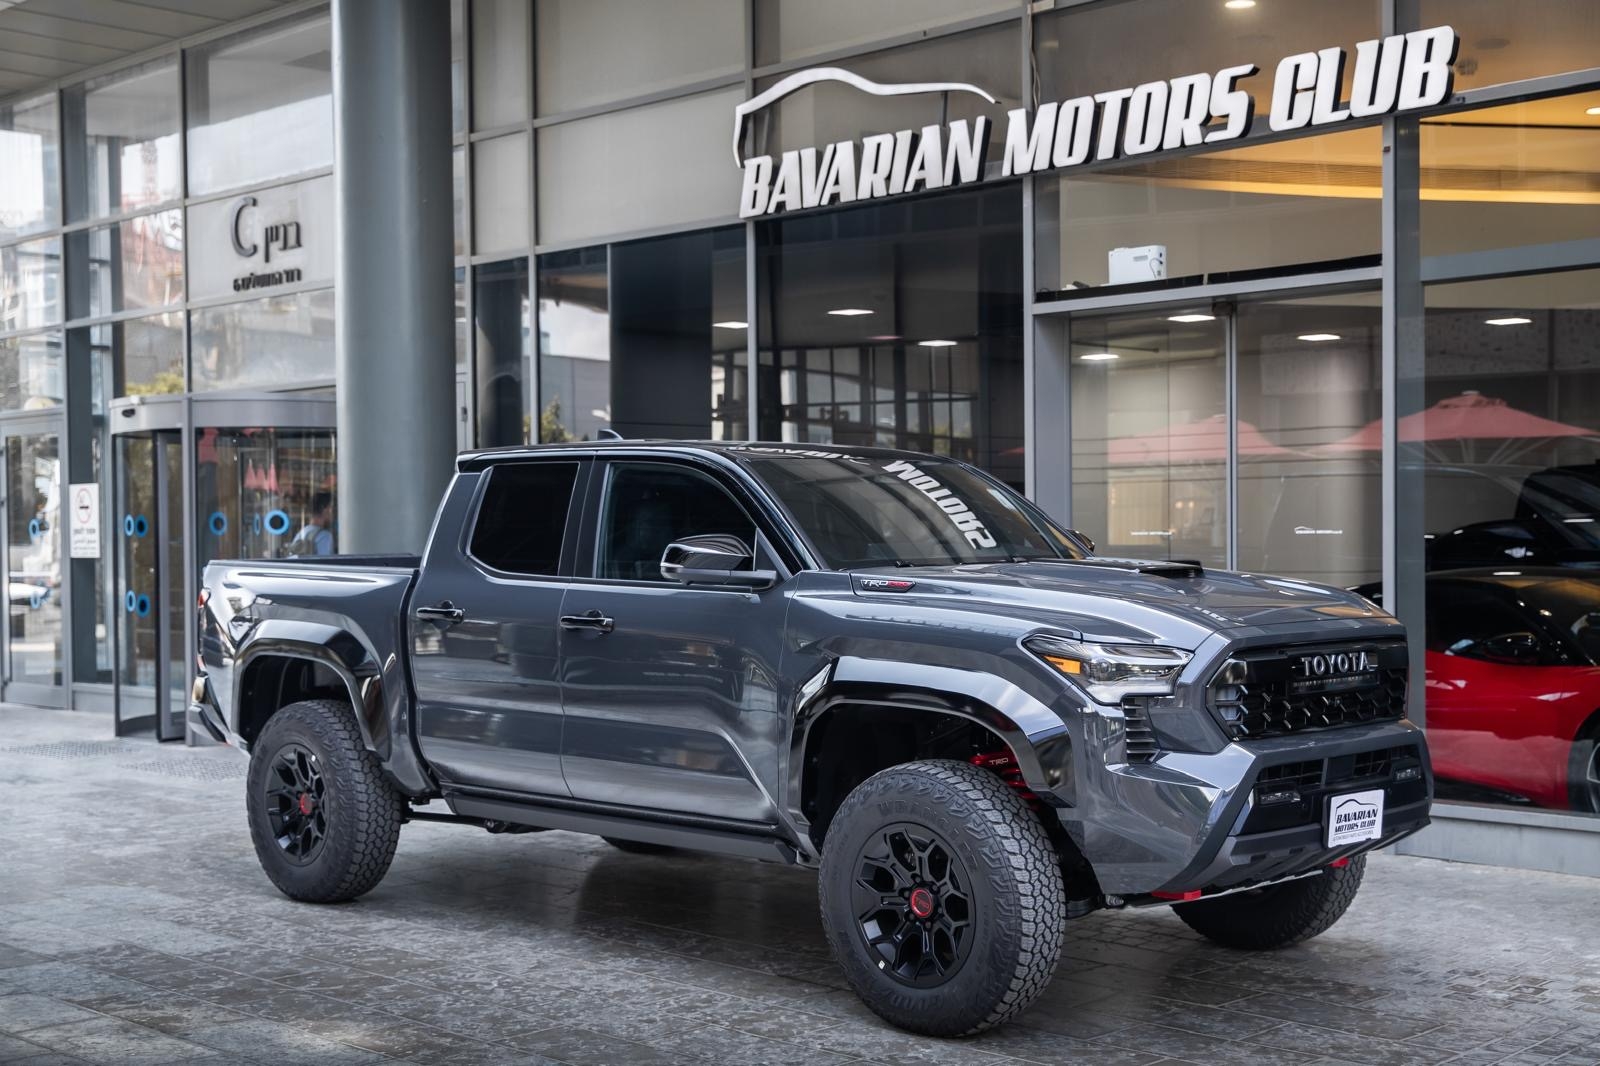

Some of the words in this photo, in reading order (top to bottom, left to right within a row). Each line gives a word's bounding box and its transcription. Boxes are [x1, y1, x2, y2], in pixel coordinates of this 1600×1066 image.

[739, 115, 991, 219] BAVARIAN
[1001, 64, 1257, 176] MOTORS
[1269, 25, 1460, 132] CLUB
[231, 197, 258, 258] C
[264, 221, 302, 263] בניין
[863, 579, 889, 588] TRD
[1301, 651, 1370, 676] TOYOTA
[1334, 822, 1359, 833] MOTORS
[1360, 819, 1376, 829] CLUB
[1336, 808, 1379, 824] BAVARIAN
